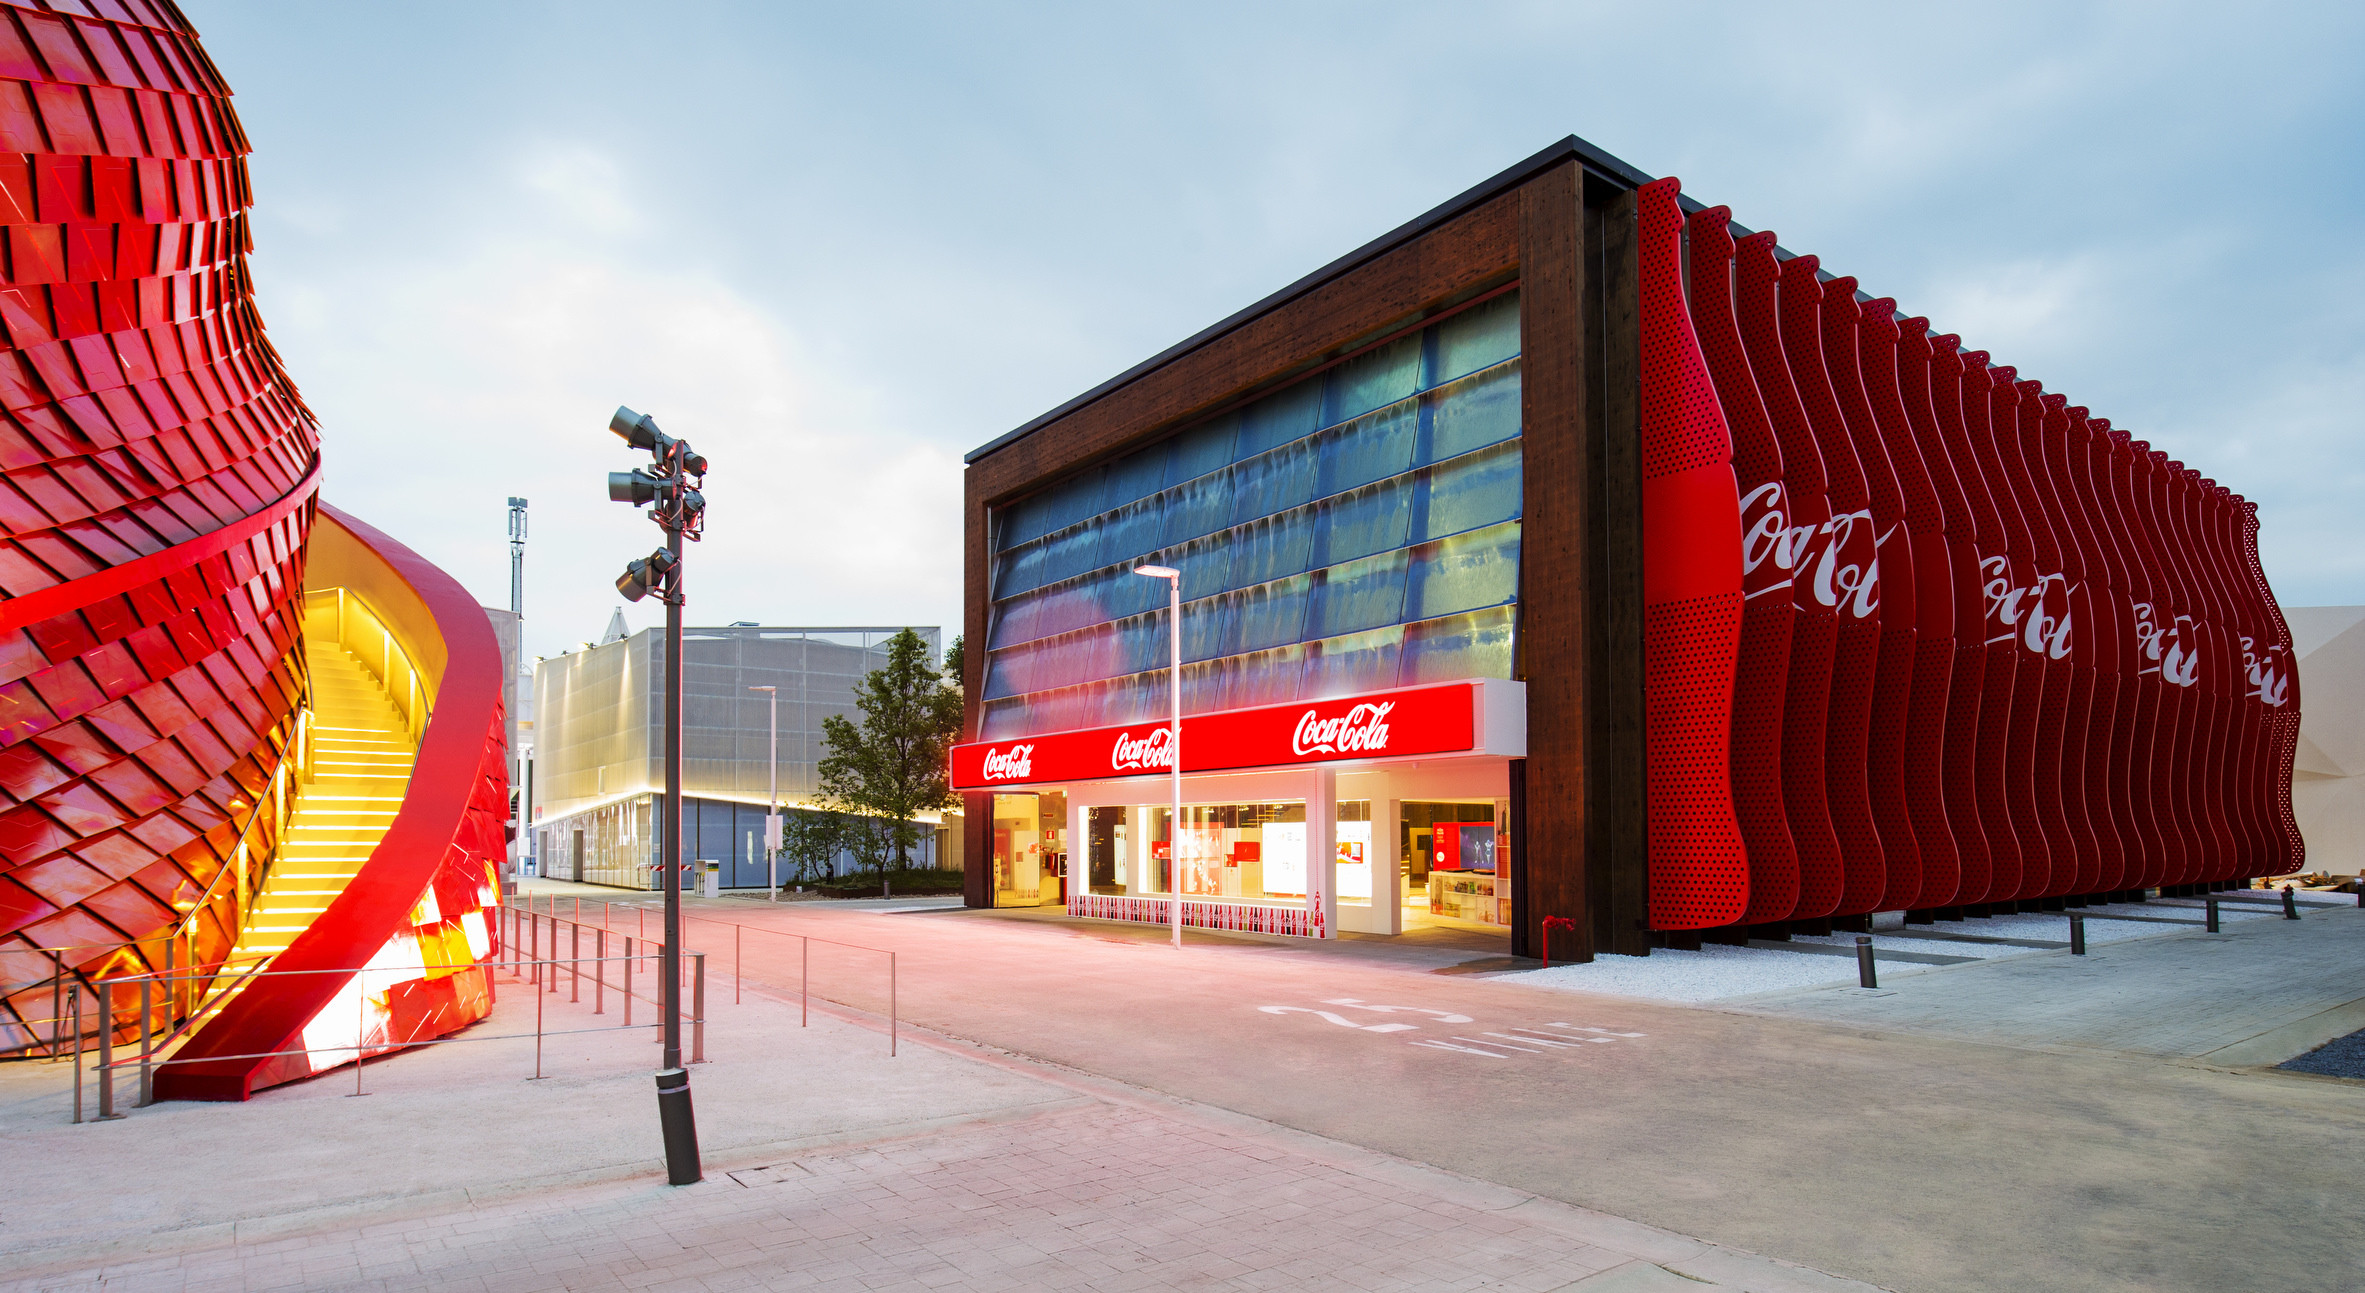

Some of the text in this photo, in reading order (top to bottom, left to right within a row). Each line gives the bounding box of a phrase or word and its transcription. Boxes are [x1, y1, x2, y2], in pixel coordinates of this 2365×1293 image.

[1292, 701, 1396, 756] Coca-Cola
[983, 744, 1034, 780] Coca-Cola
[1256, 998, 1474, 1033] 25
[1408, 1022, 1648, 1058] VIALE
